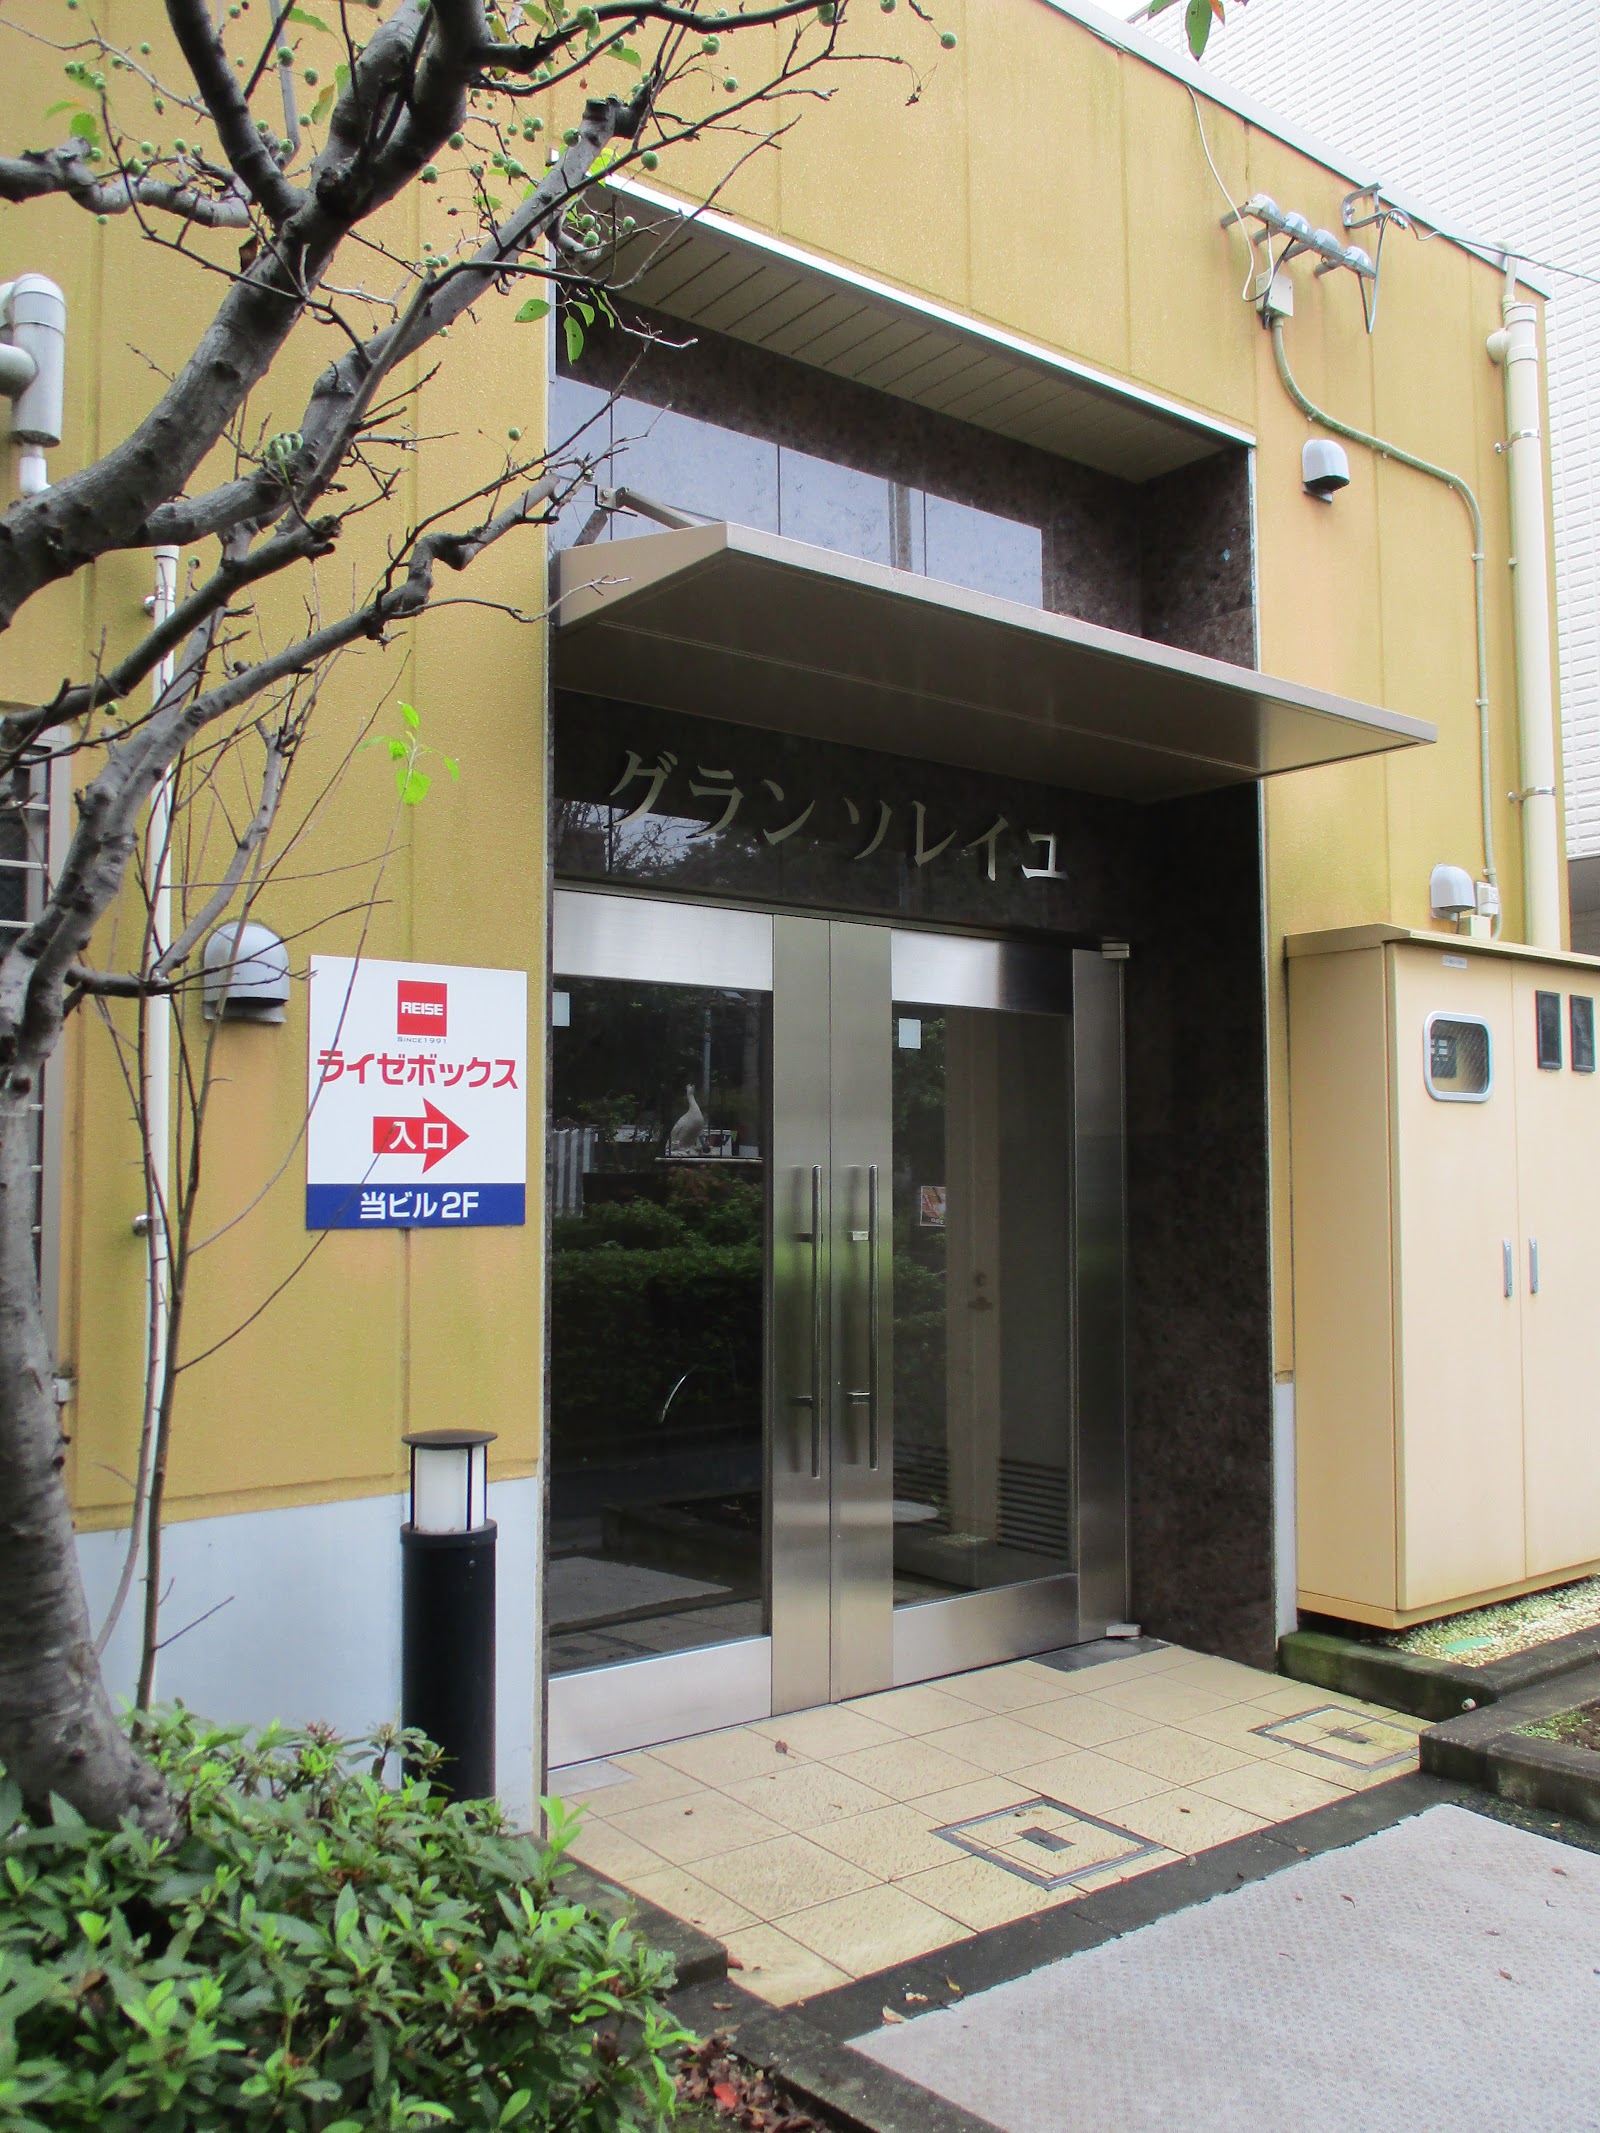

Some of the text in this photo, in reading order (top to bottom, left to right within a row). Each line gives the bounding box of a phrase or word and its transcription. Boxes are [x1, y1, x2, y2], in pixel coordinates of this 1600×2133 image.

[603, 749, 1068, 882] グランソレイユ
[401, 1001, 444, 1016] REISE
[317, 1050, 518, 1089] ライゼボックス
[389, 1121, 447, 1150] 入口
[360, 1191, 479, 1220] 当ビル2F
